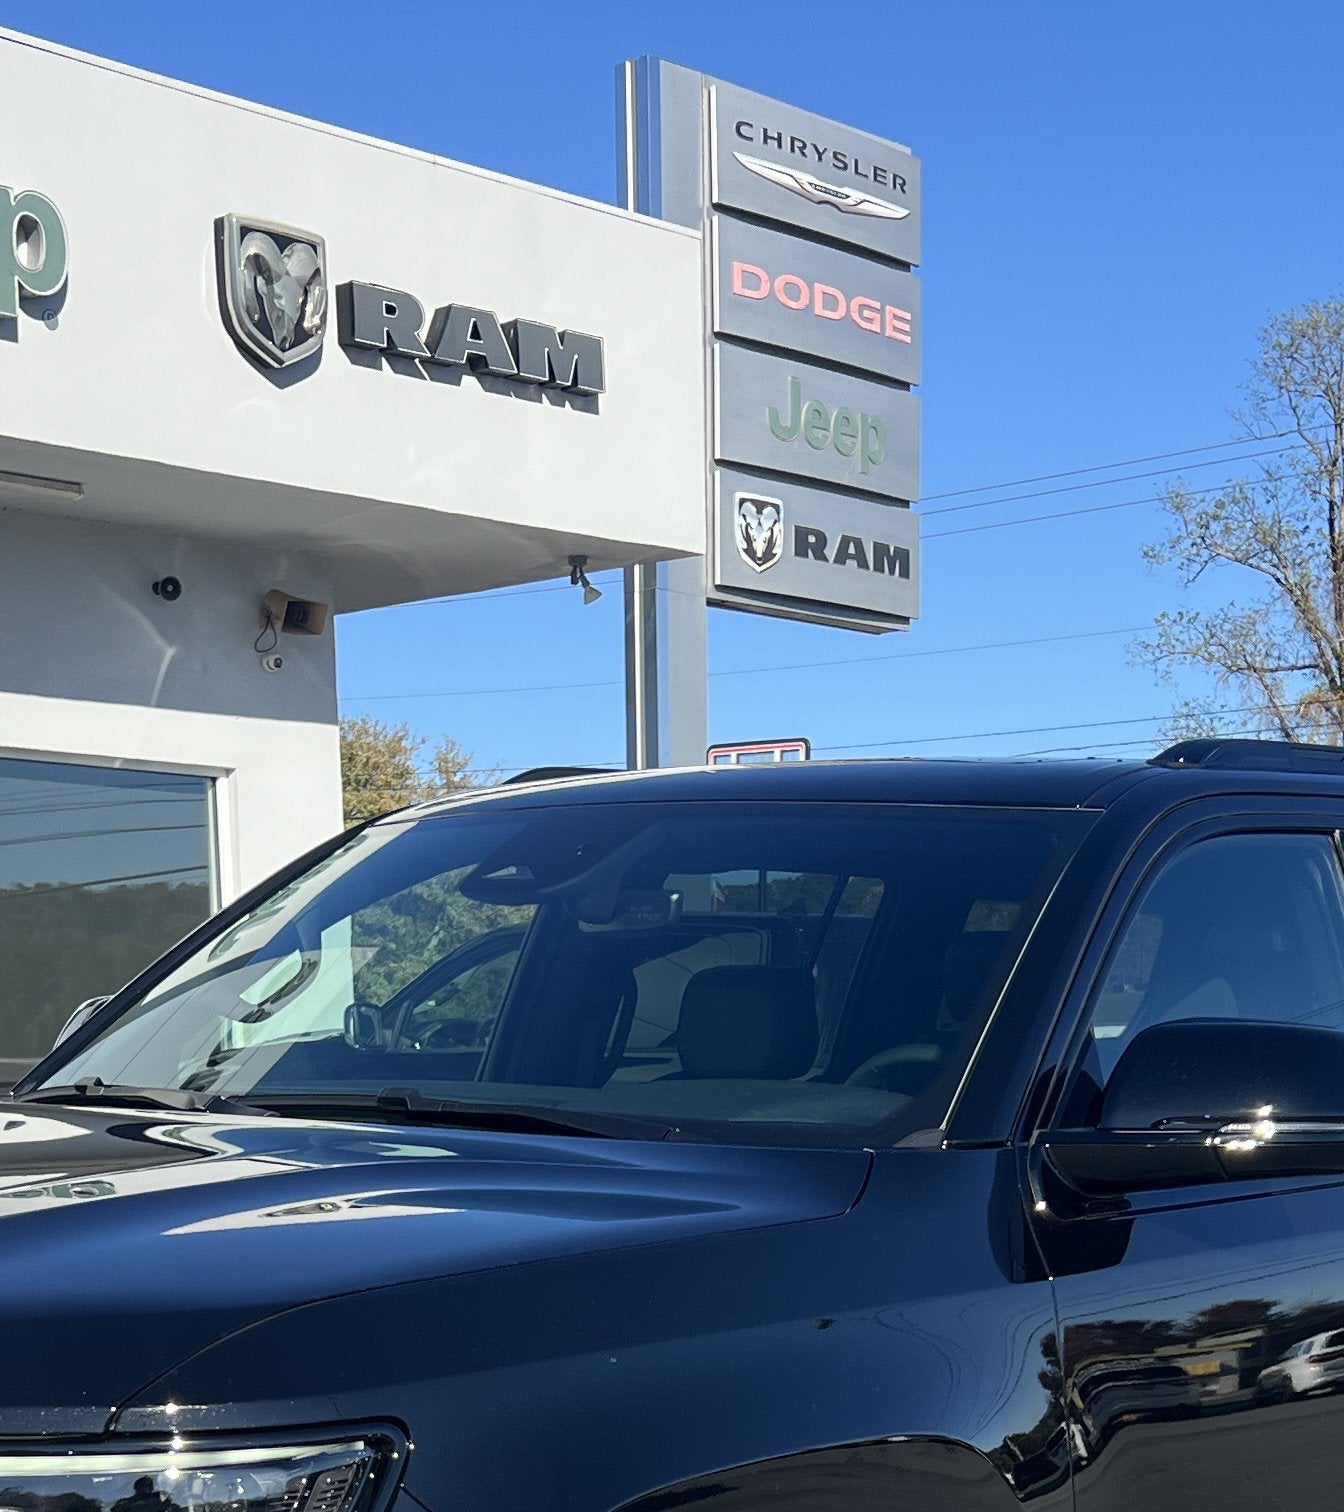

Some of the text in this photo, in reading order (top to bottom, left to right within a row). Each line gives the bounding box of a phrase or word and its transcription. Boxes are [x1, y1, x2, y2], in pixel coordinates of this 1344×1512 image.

[735, 120, 907, 194] CHRYSLER
[336, 280, 606, 393] RAM
[731, 261, 912, 344] DODGE
[766, 376, 888, 475] Jeep
[792, 525, 910, 580] RAM
